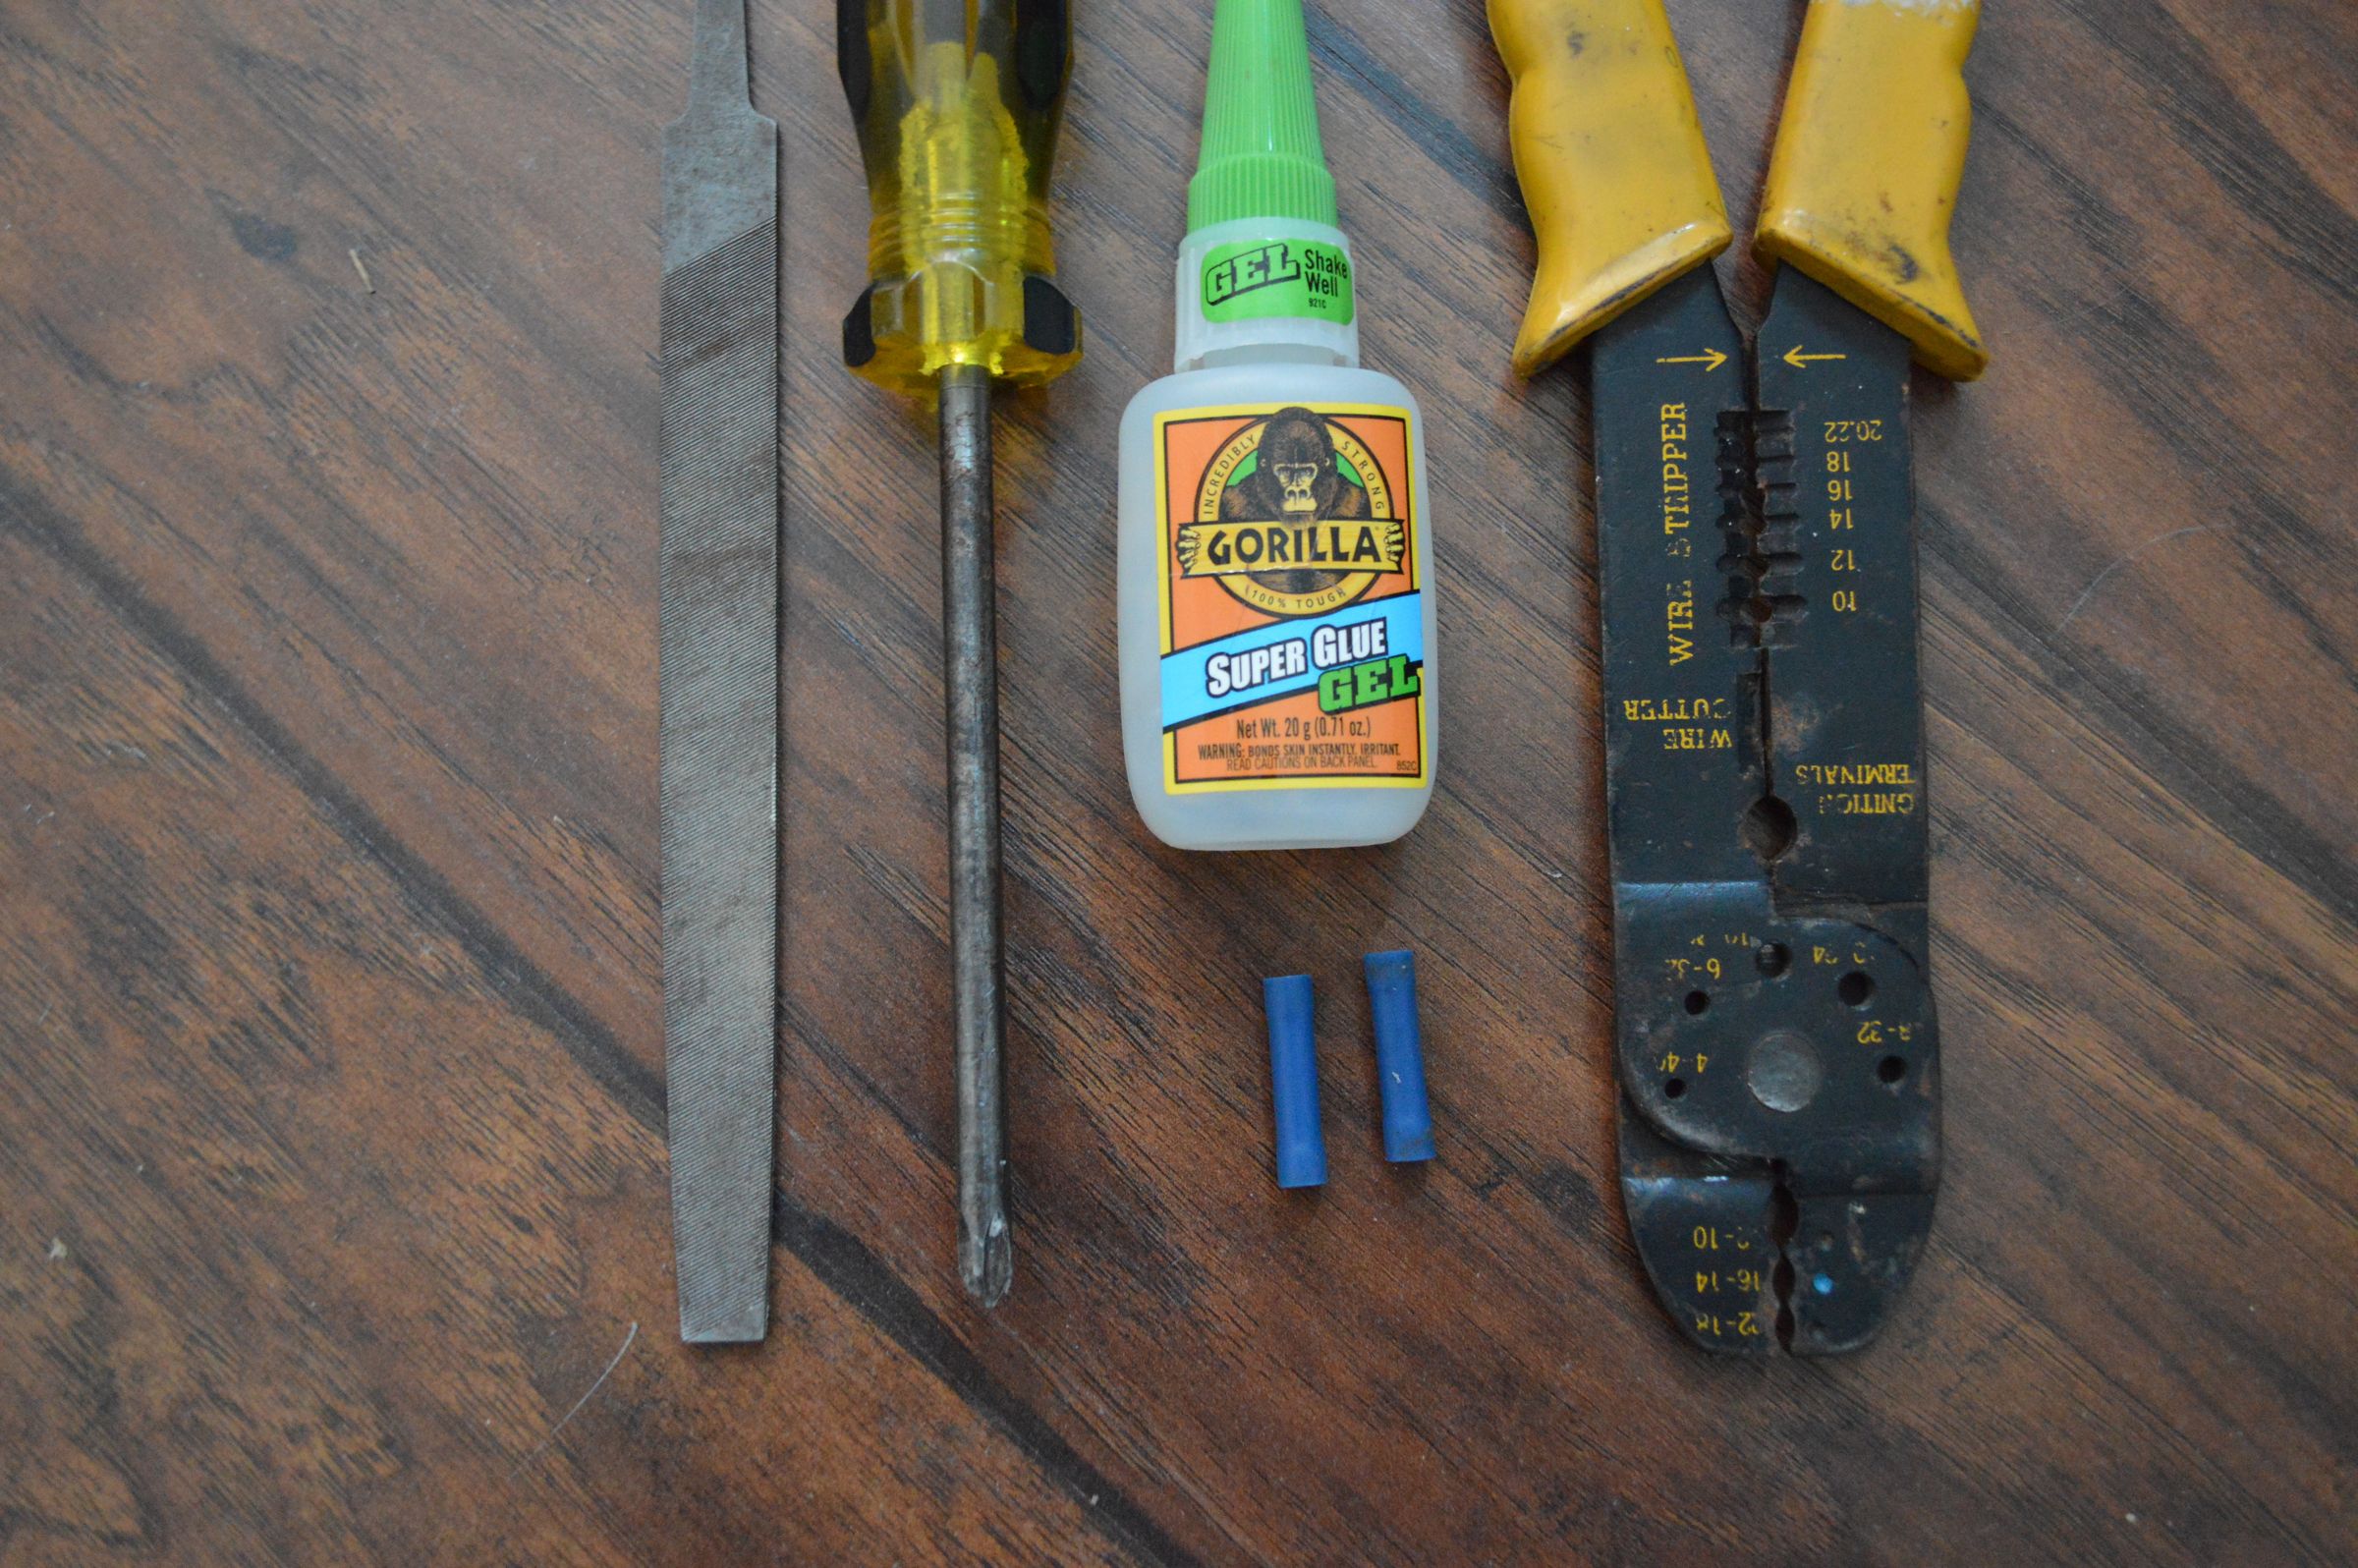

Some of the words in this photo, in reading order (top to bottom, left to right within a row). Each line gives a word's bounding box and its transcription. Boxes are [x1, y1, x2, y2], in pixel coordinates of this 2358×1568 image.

[1206, 244, 1300, 306] GEL
[1305, 249, 1347, 279] Shake
[1305, 271, 1338, 297] Well
[1826, 451, 1851, 474] 18
[1204, 434, 1256, 515] INCREDIBLY
[1342, 441, 1385, 511] STRONG
[1827, 479, 1854, 502] 16
[1829, 508, 1855, 531] 14
[1207, 526, 1381, 565] GORILLA
[1830, 549, 1857, 572] 12
[1251, 589, 1287, 608] 100%
[1295, 588, 1347, 608] TOUGH
[1832, 590, 1858, 612] 10
[1205, 637, 1308, 698] SUPER
[1312, 617, 1388, 669] GLUE
[1319, 653, 1421, 714] GEL
[1236, 718, 1258, 739] Net
[1261, 716, 1280, 738] Wt.
[1285, 717, 1299, 737] 20
[1303, 721, 1311, 741] g
[1315, 716, 1344, 738] (0.71
[1349, 716, 1371, 737] oz.)
[1662, 728, 1733, 750] WIRE
[1198, 743, 1245, 760] WARNING:
[1248, 745, 1280, 757] BONDS
[1283, 744, 1306, 756] SKIN
[1226, 757, 1252, 771] READ
[1254, 756, 1301, 770] CAUTIONS
[1304, 755, 1318, 768] ON
[1320, 756, 1344, 768] BACK
